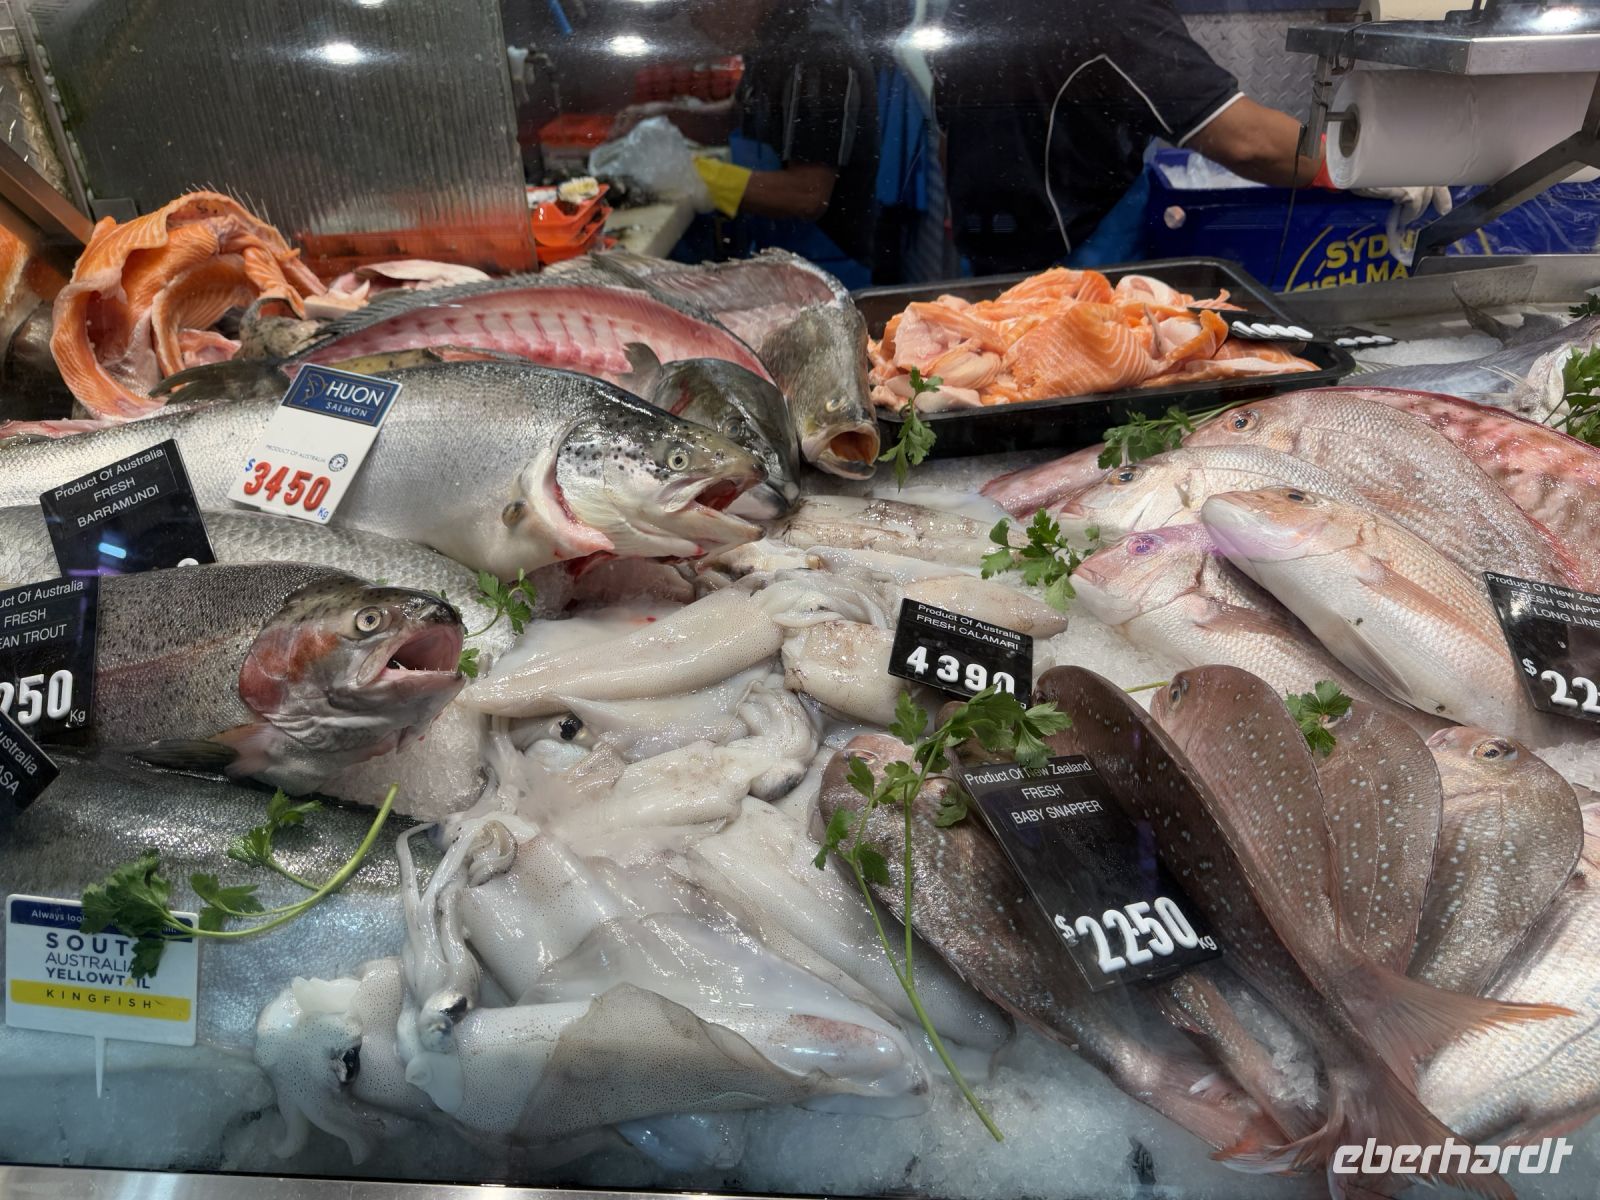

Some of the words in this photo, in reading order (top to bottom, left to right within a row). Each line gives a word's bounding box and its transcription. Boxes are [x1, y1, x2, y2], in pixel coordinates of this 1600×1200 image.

[326, 380, 385, 407] HUON
[325, 401, 368, 417] SALMON
[54, 477, 98, 502] Product
[99, 468, 114, 482] Of
[116, 449, 165, 476] Australia
[93, 477, 137, 503] FRESH
[77, 484, 160, 528] BARRAMUNDI
[17, 590, 32, 604] Of
[33, 580, 84, 600] Australia
[1487, 573, 1531, 590] Product
[1532, 583, 1547, 593] Of
[1548, 586, 1575, 599] New
[4, 607, 47, 628] FRESH
[1533, 607, 1571, 622] LONG
[1557, 600, 1600, 615] SNAPP
[23, 623, 67, 644] TROUT
[916, 614, 957, 632] FRESH
[958, 627, 1019, 651] CALAMARI
[918, 604, 958, 622] Product
[959, 617, 974, 626] Of
[975, 622, 1021, 641] Australia
[906, 645, 1015, 695] 4390
[69, 708, 86, 723] Kg
[964, 769, 1009, 786] Product
[1008, 767, 1025, 780] Of
[1048, 760, 1092, 776] Zealand
[1021, 783, 1065, 800] FRESH
[1011, 808, 1045, 824] BABY
[1045, 800, 1104, 819] SNAPPER
[31, 909, 64, 921] Always
[67, 913, 85, 923] loo
[45, 932, 129, 957] SOUT
[46, 989, 152, 1009] KINGFISH
